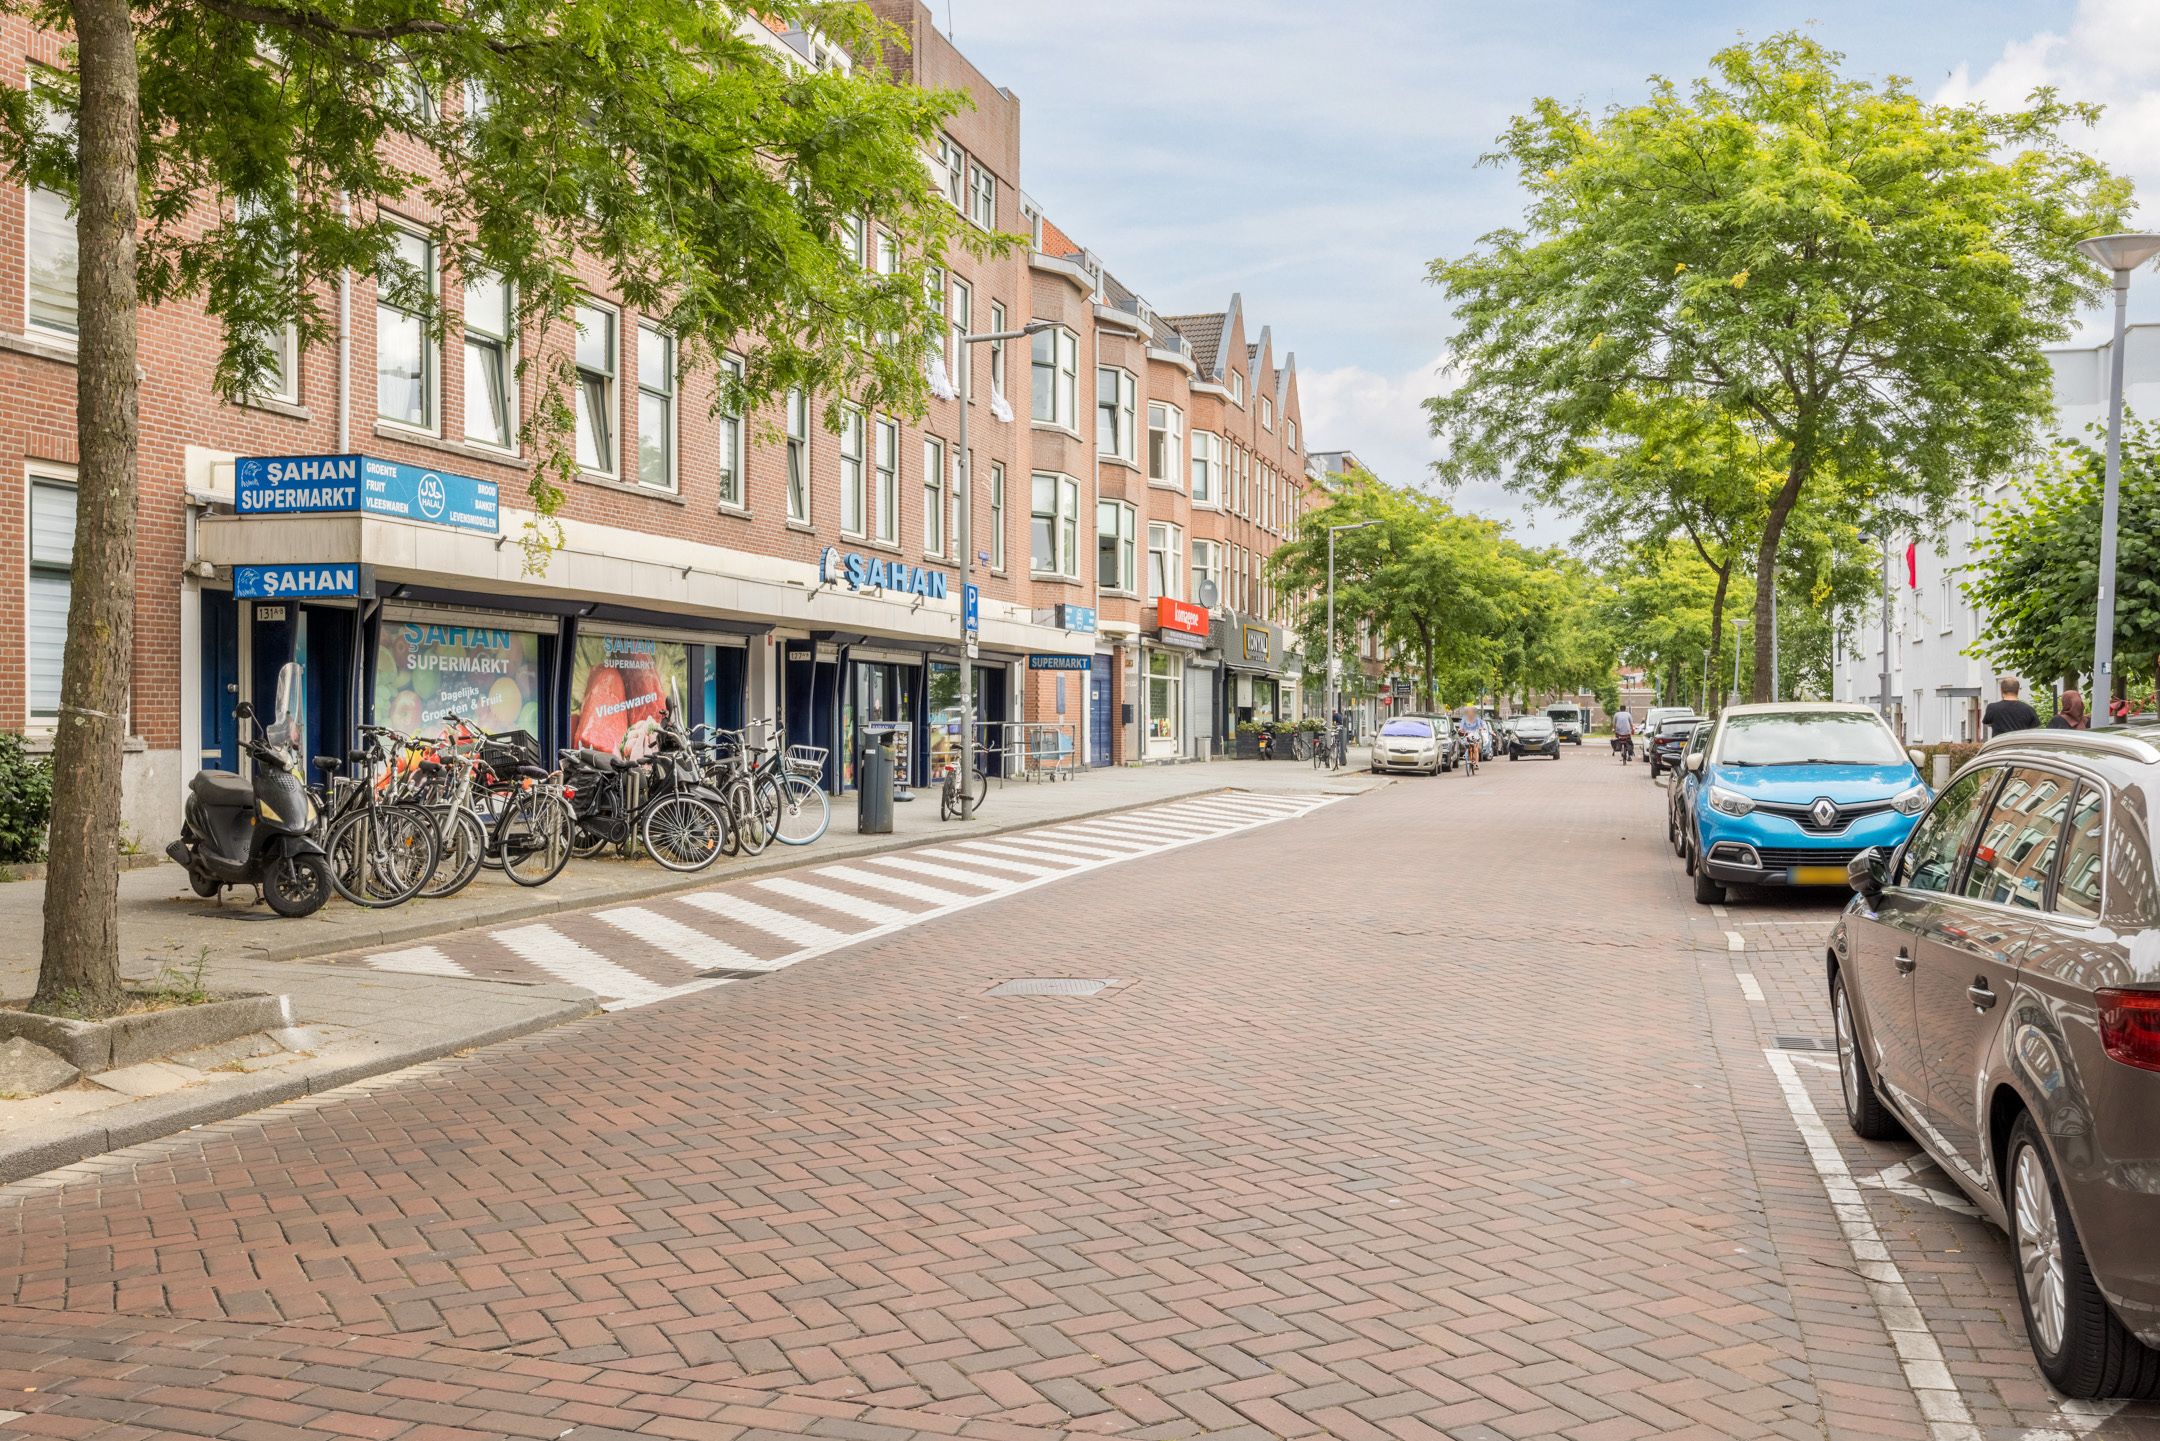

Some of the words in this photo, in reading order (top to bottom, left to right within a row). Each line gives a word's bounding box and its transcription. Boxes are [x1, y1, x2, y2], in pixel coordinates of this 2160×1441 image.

[267, 461, 356, 486] ŞAHAN
[366, 462, 397, 478] GROENTE
[366, 479, 386, 493] FRUIT
[477, 484, 496, 497] BROOD
[241, 487, 356, 509] SUPERMARKT
[365, 496, 409, 514] VLEESWAREN
[422, 498, 441, 509] HALAL
[474, 499, 497, 513] BANKET
[449, 511, 497, 529] LEVENSMIDDELEN
[263, 570, 354, 597] ŞAHAN
[843, 552, 947, 600] ŞAHAN
[968, 588, 976, 612] P
[404, 623, 511, 652] ŞAHAN
[406, 653, 510, 674] SUPERMARKT
[603, 659, 655, 669] SUPERMARKT
[1031, 657, 1088, 669] SUPERMARKT
[441, 686, 480, 702] Dagelijks
[470, 699, 478, 710] &
[480, 693, 503, 708] Fruit
[595, 692, 658, 718] Vleeswaren
